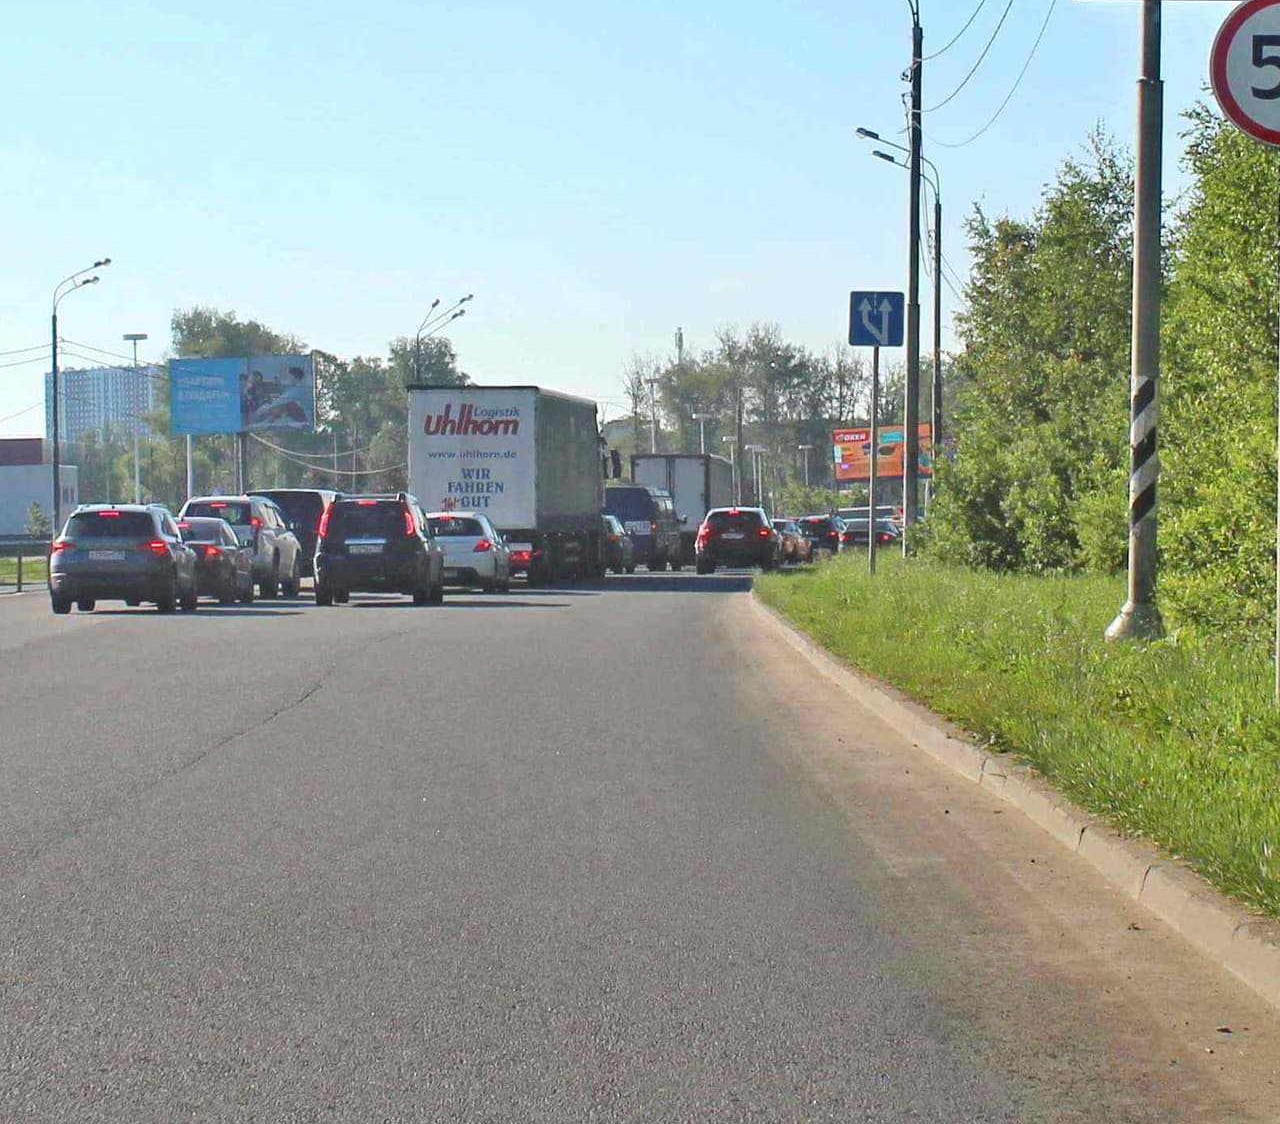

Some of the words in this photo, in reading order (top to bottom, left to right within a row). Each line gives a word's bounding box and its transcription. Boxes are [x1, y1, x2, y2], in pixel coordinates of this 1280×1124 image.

[473, 406, 521, 419] Logistik
[423, 403, 520, 436] uhlhorn
[427, 449, 518, 460] www.uhlhorn.de
[460, 467, 491, 480] WIR
[447, 481, 505, 494] FAHREN
[460, 496, 491, 508] GUT
